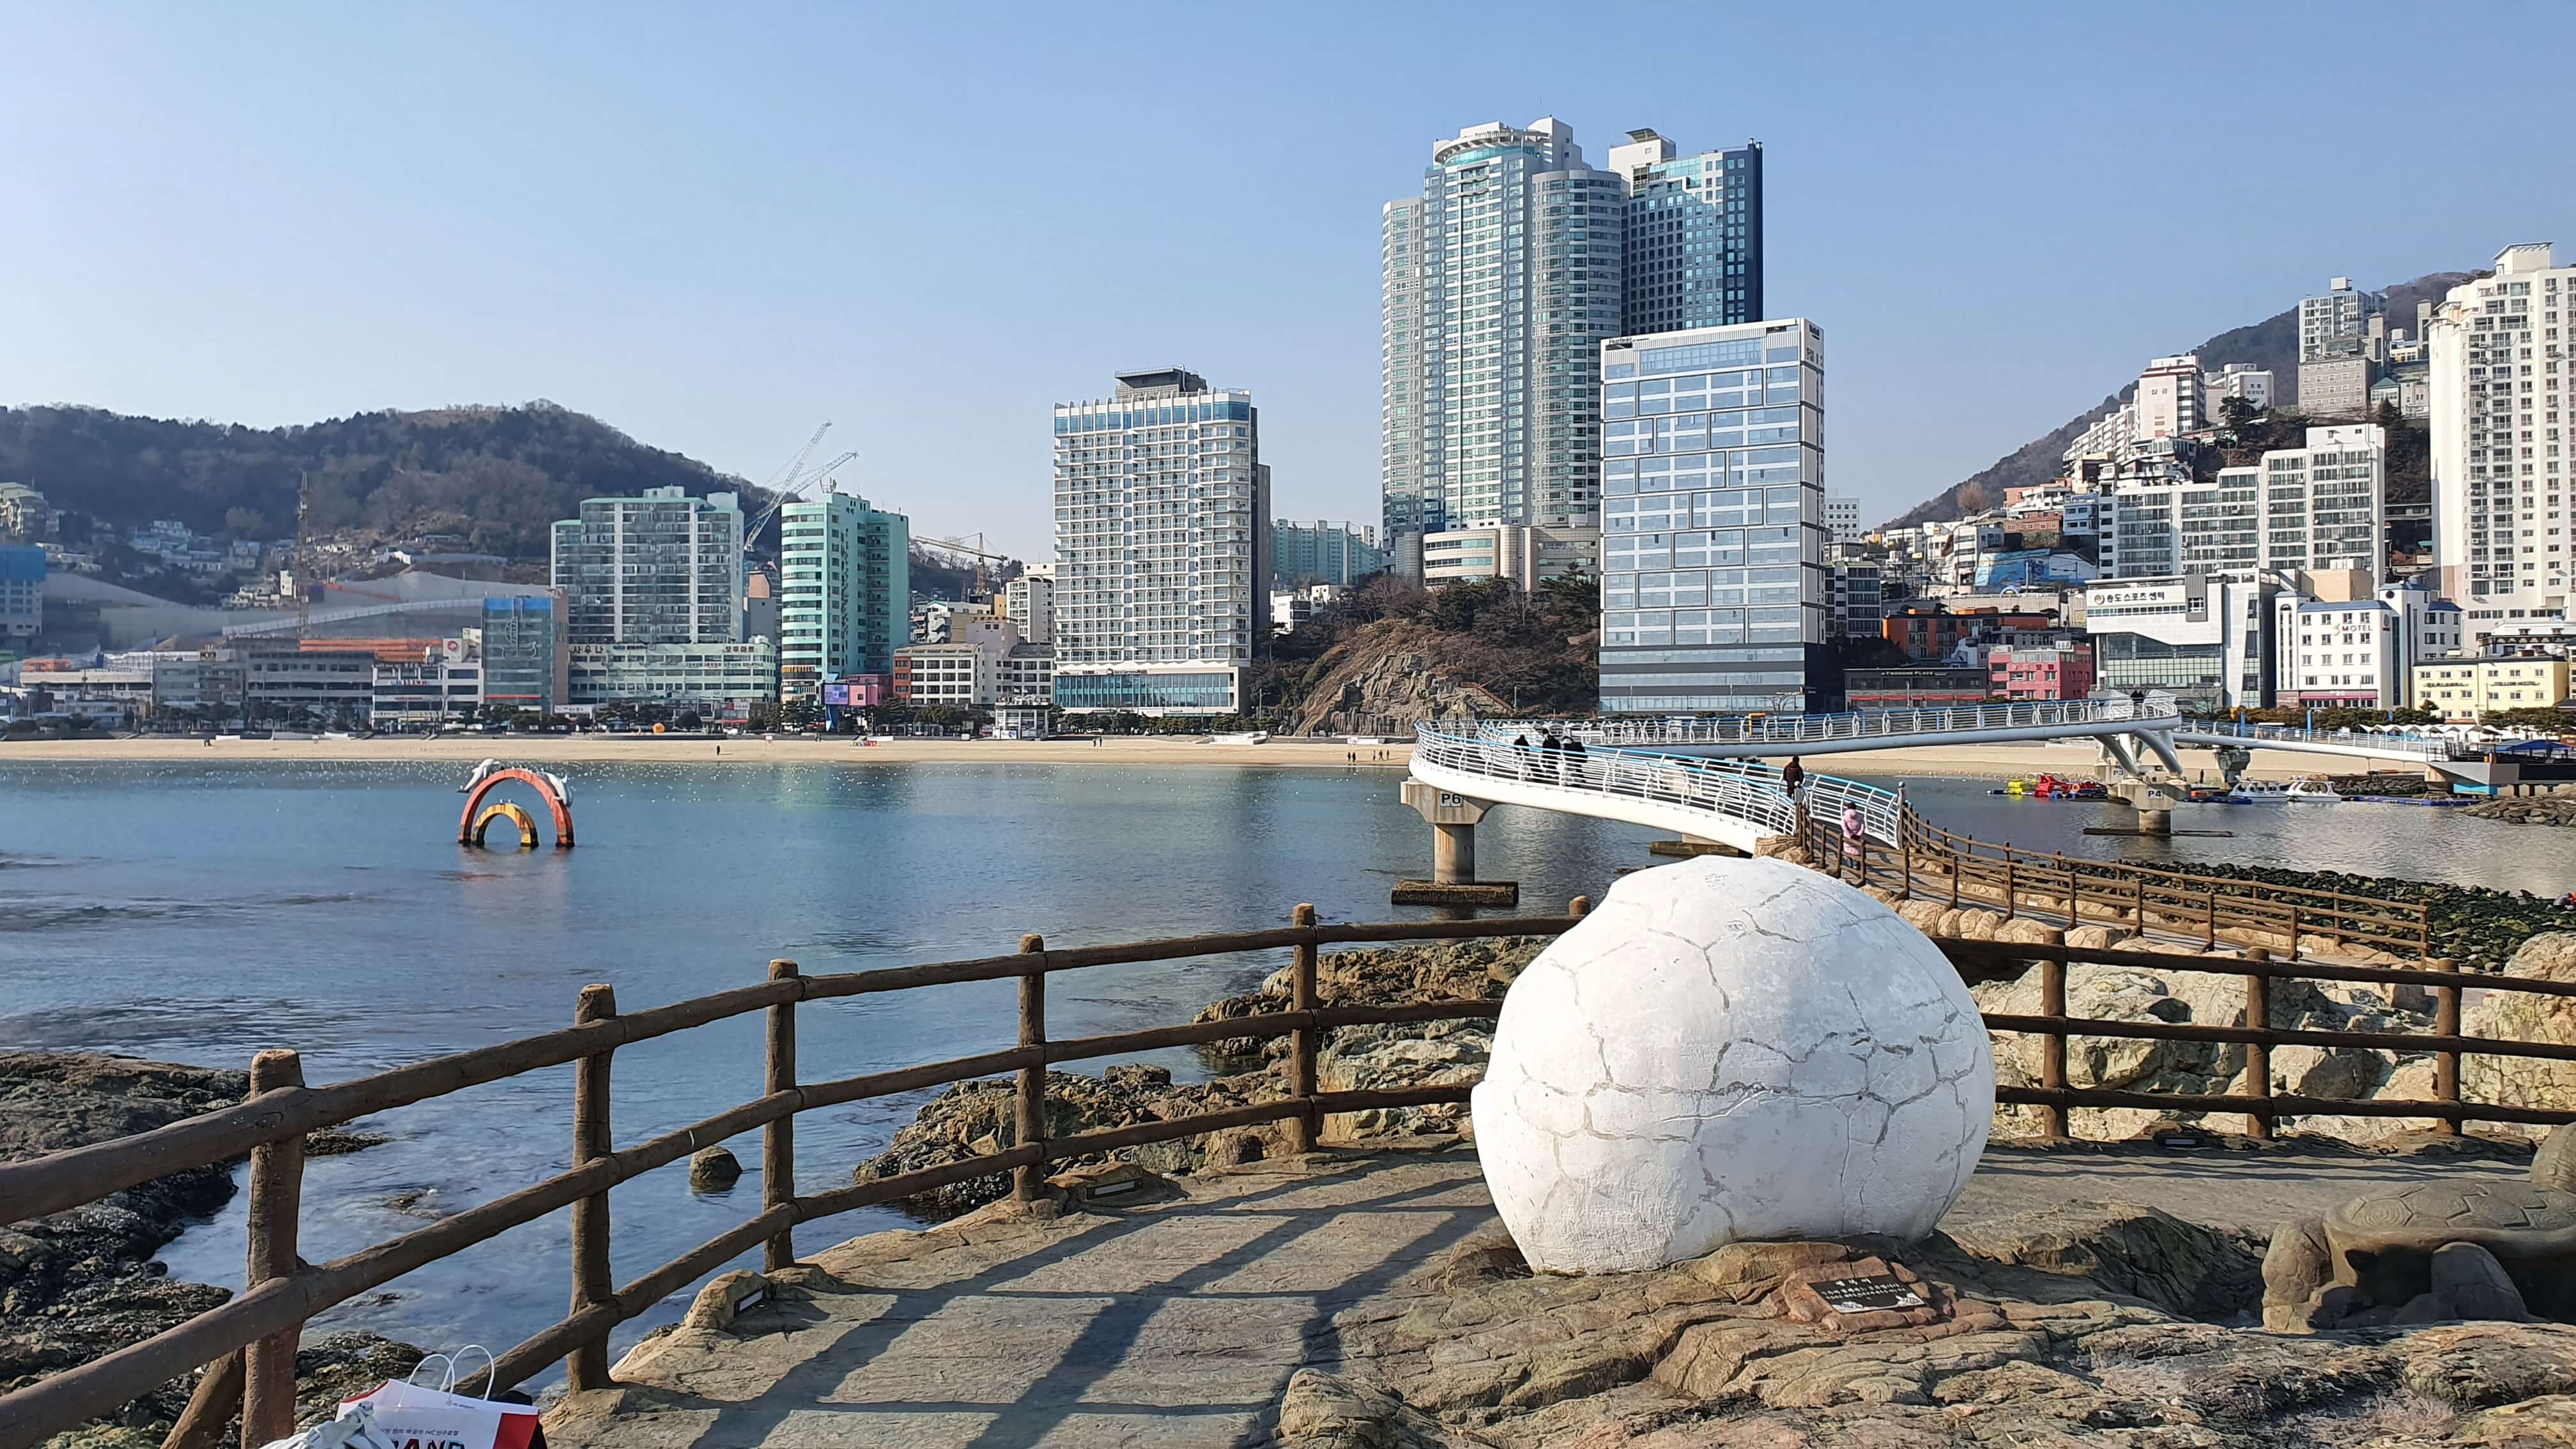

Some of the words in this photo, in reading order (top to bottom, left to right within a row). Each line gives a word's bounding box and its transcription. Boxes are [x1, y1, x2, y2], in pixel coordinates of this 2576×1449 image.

[2107, 594, 2122, 602] 송도
[2124, 592, 2147, 602] 스포츠
[2149, 592, 2165, 601] 센터
[572, 645, 603, 654] 사우나
[1441, 793, 1462, 804] P6
